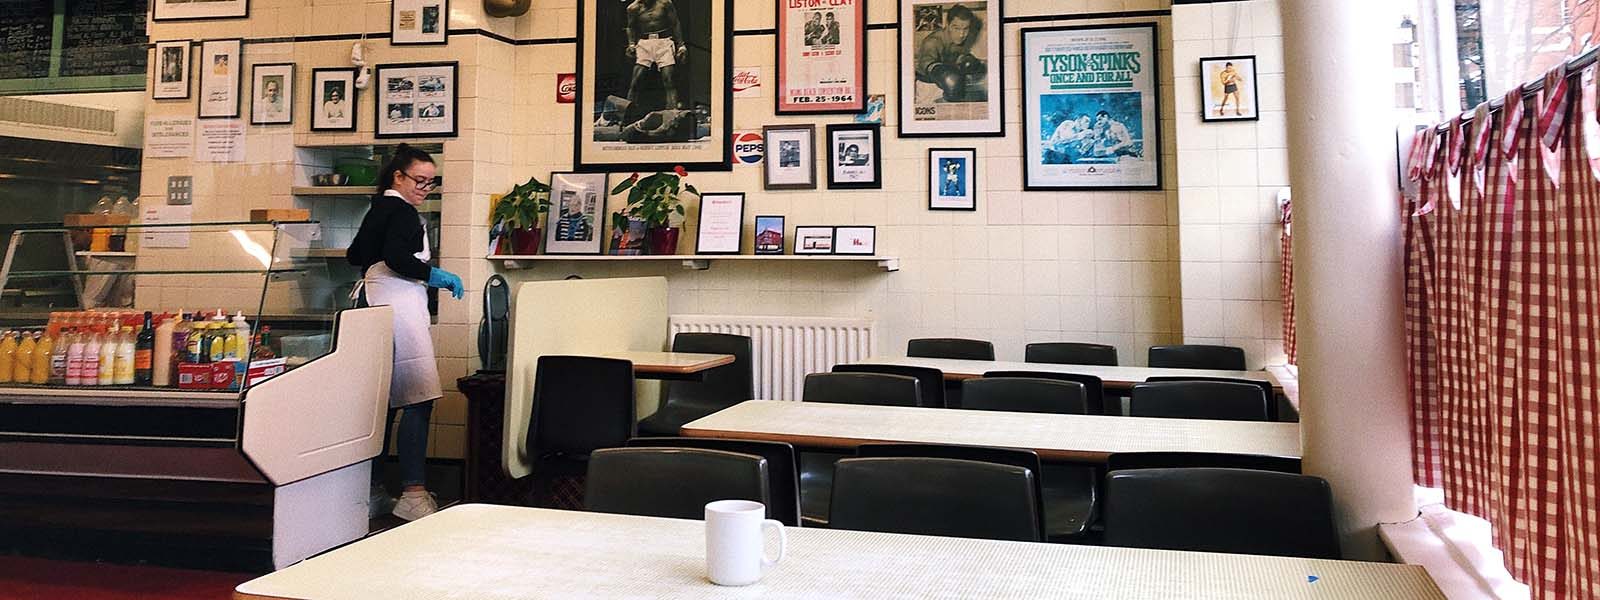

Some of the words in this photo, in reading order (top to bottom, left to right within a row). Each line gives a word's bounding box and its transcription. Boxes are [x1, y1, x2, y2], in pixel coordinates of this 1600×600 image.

[789, 0, 820, 8] LISTON
[1039, 54, 1087, 77] TYSON
[1091, 52, 1141, 74] SPINKS
[1050, 73, 1075, 83] ONCE
[1076, 73, 1094, 83] AND
[1096, 72, 1113, 82] FOR
[1114, 71, 1133, 81] ALL
[915, 106, 936, 115] ICONS
[735, 143, 764, 153] PEPS
